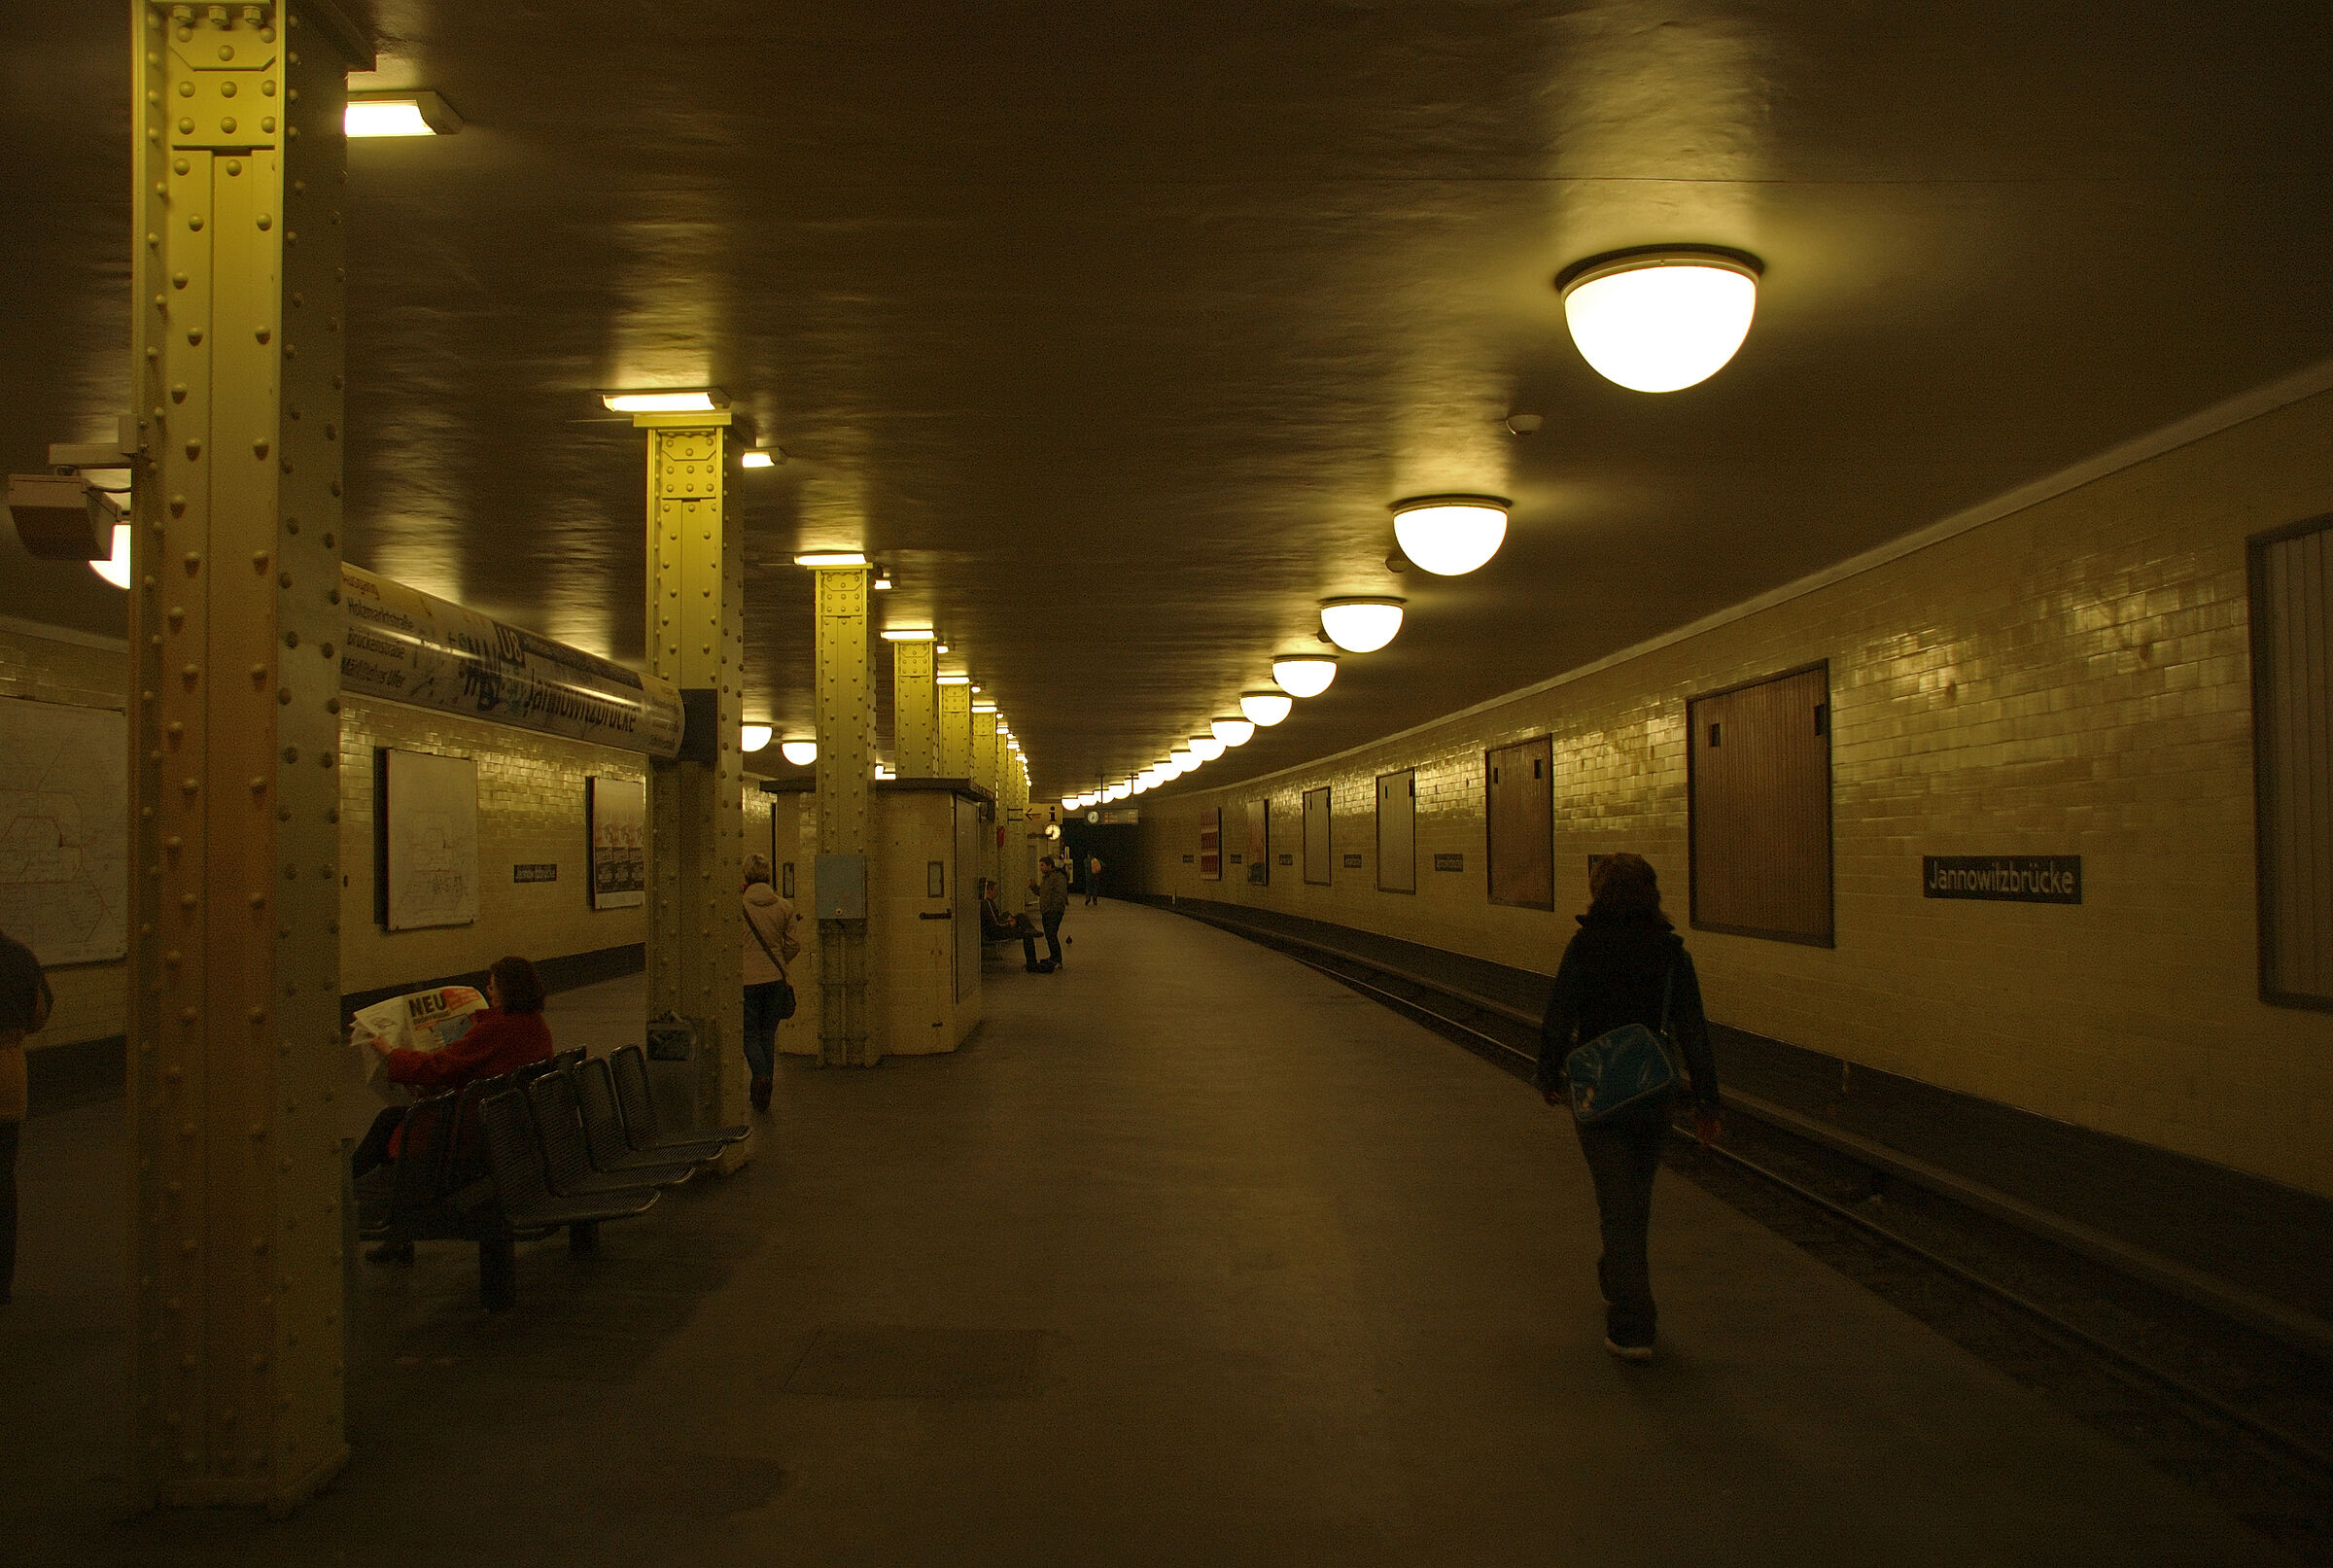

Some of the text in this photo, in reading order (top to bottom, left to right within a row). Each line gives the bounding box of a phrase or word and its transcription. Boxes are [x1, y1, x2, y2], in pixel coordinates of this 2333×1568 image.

[497, 625, 524, 663] U8
[1929, 859, 2075, 895] Jannowitzbrücke
[407, 992, 447, 1018] NEU
